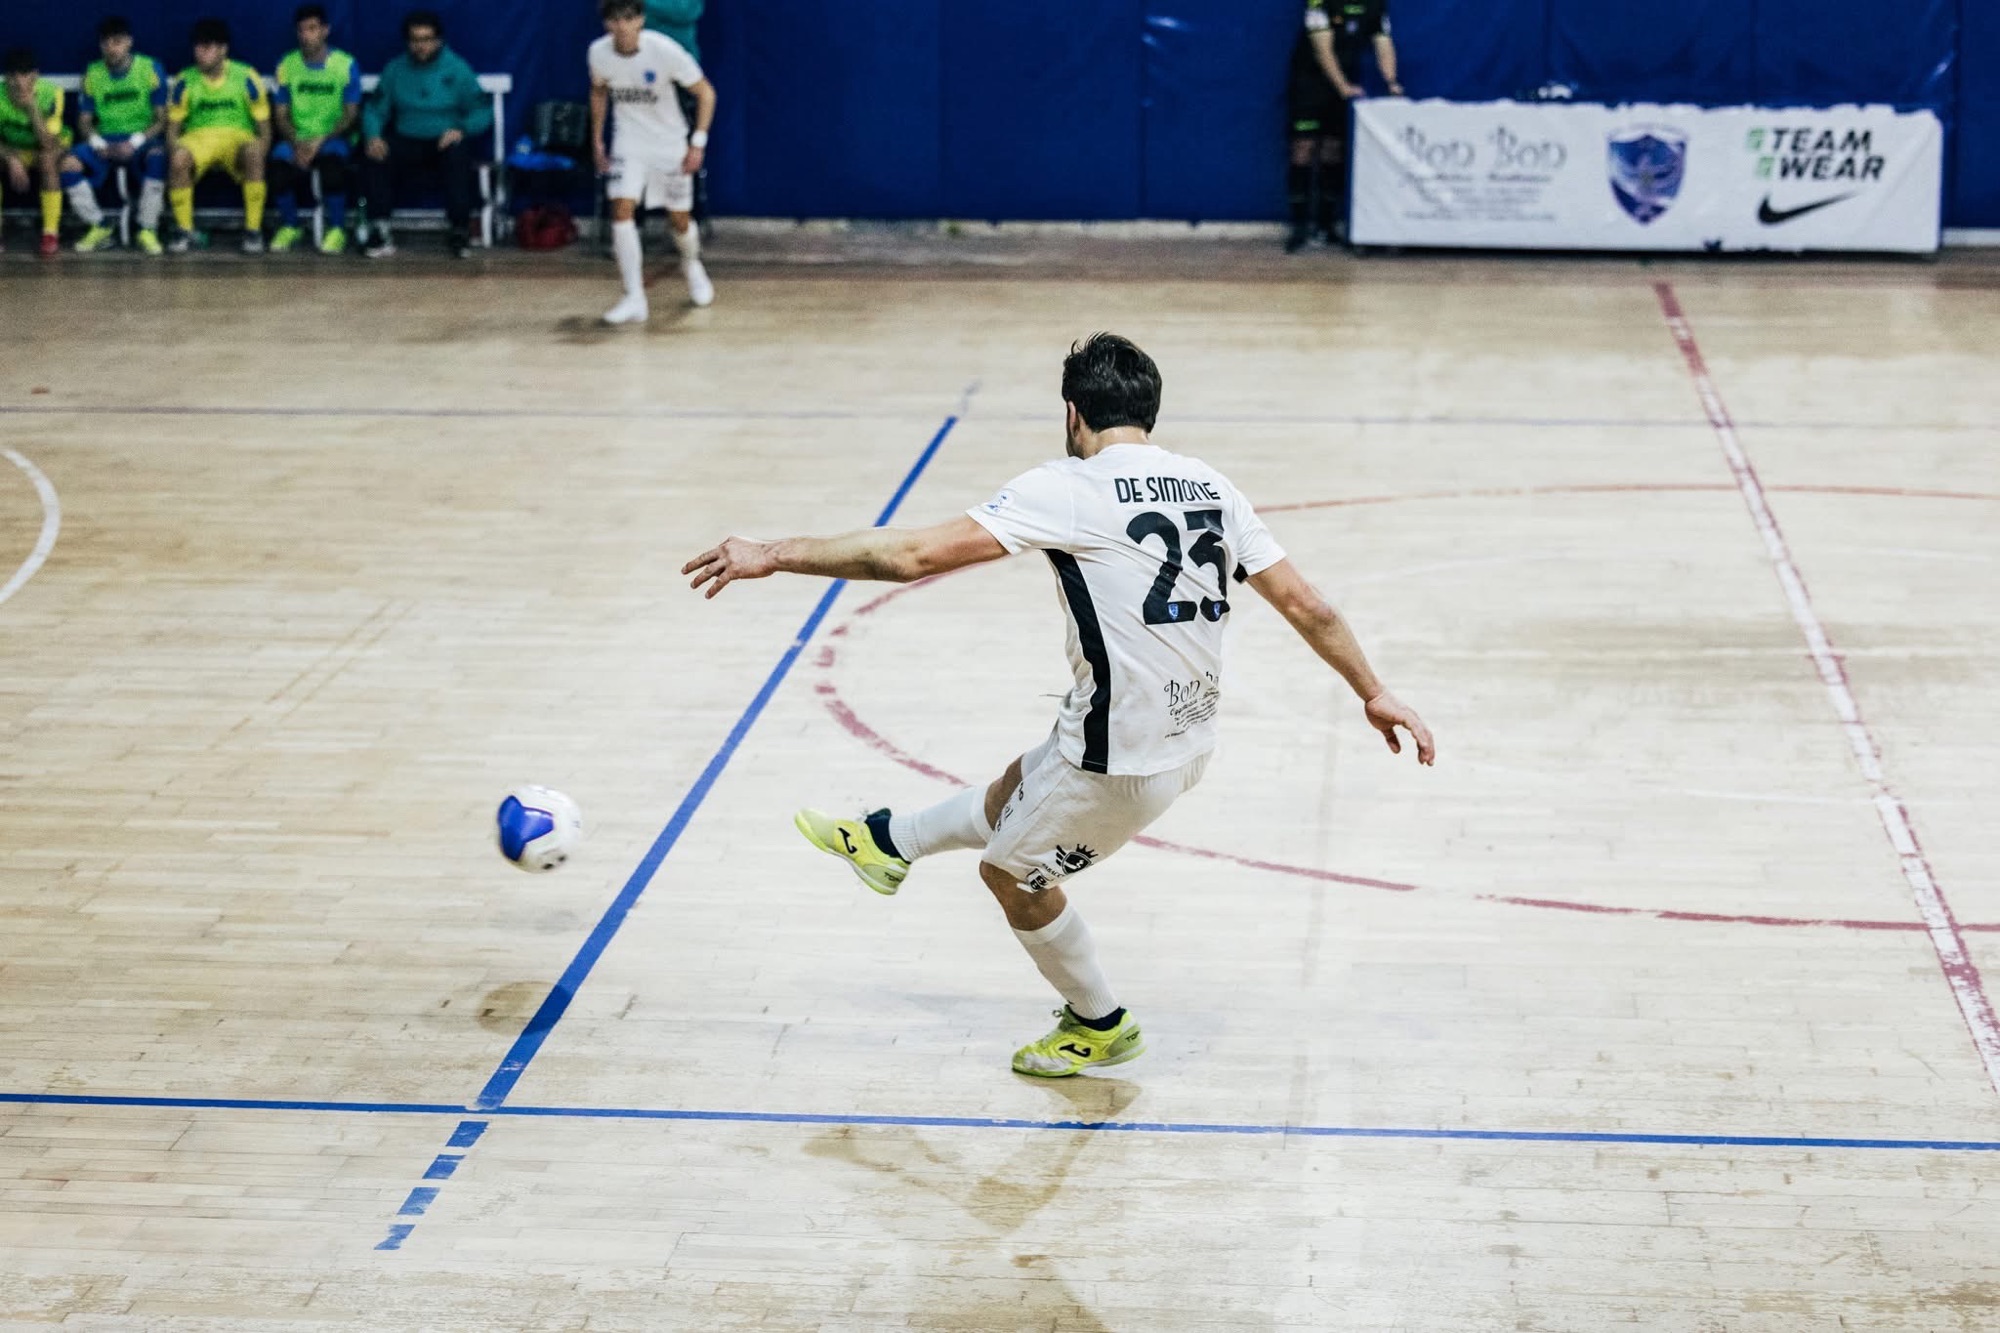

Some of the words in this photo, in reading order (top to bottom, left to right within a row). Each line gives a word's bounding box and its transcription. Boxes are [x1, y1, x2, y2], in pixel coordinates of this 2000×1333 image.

[1772, 127, 1872, 152] TEAM
[1780, 155, 1884, 180] WEAR
[1114, 477, 1144, 503] DE
[1146, 477, 1222, 503] SIMONE
[1126, 509, 1231, 625] 23
